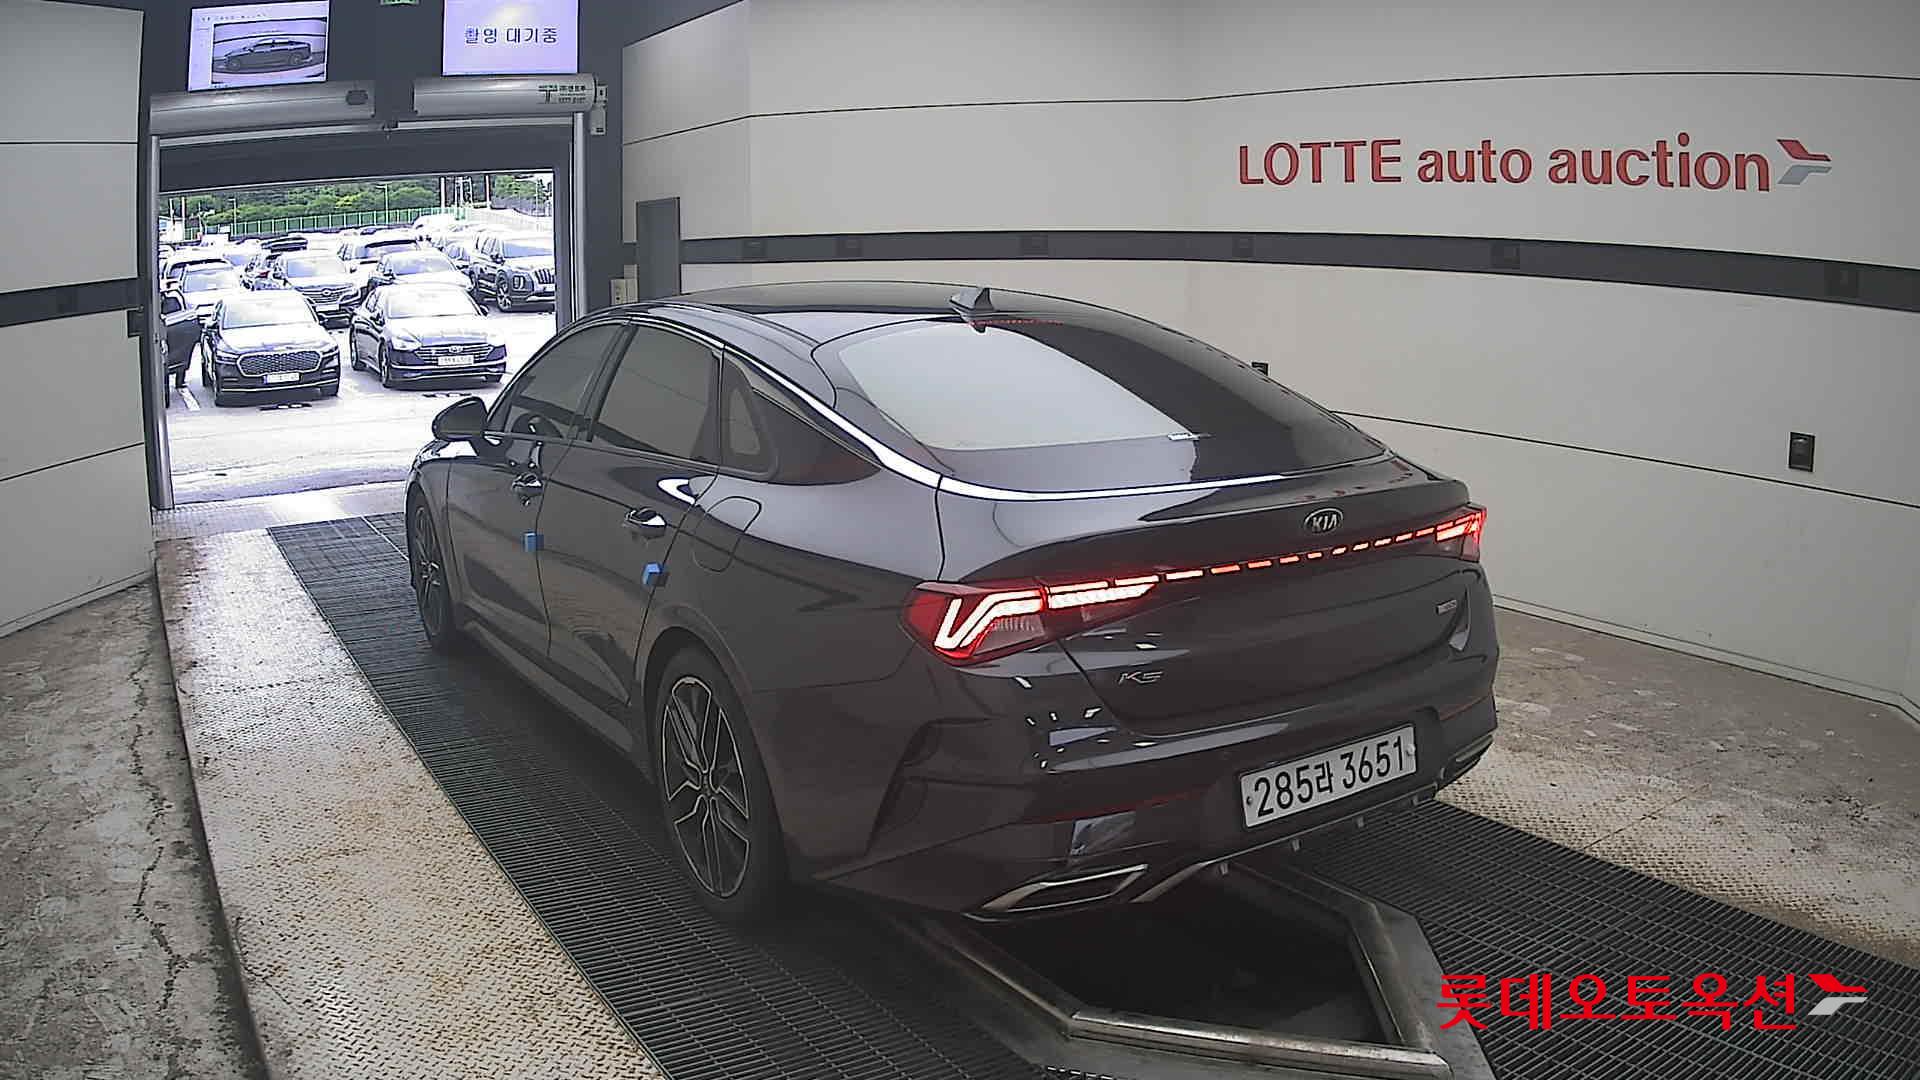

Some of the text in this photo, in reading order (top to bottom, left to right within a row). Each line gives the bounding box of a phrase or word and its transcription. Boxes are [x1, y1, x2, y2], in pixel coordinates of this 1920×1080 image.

[506, 27, 558, 44] 대기중
[1239, 132, 1771, 192] LOTTE auto auction
[1312, 514, 1338, 532] KIA
[1118, 671, 1163, 685] K5
[1254, 736, 1404, 817] 285라 3651
